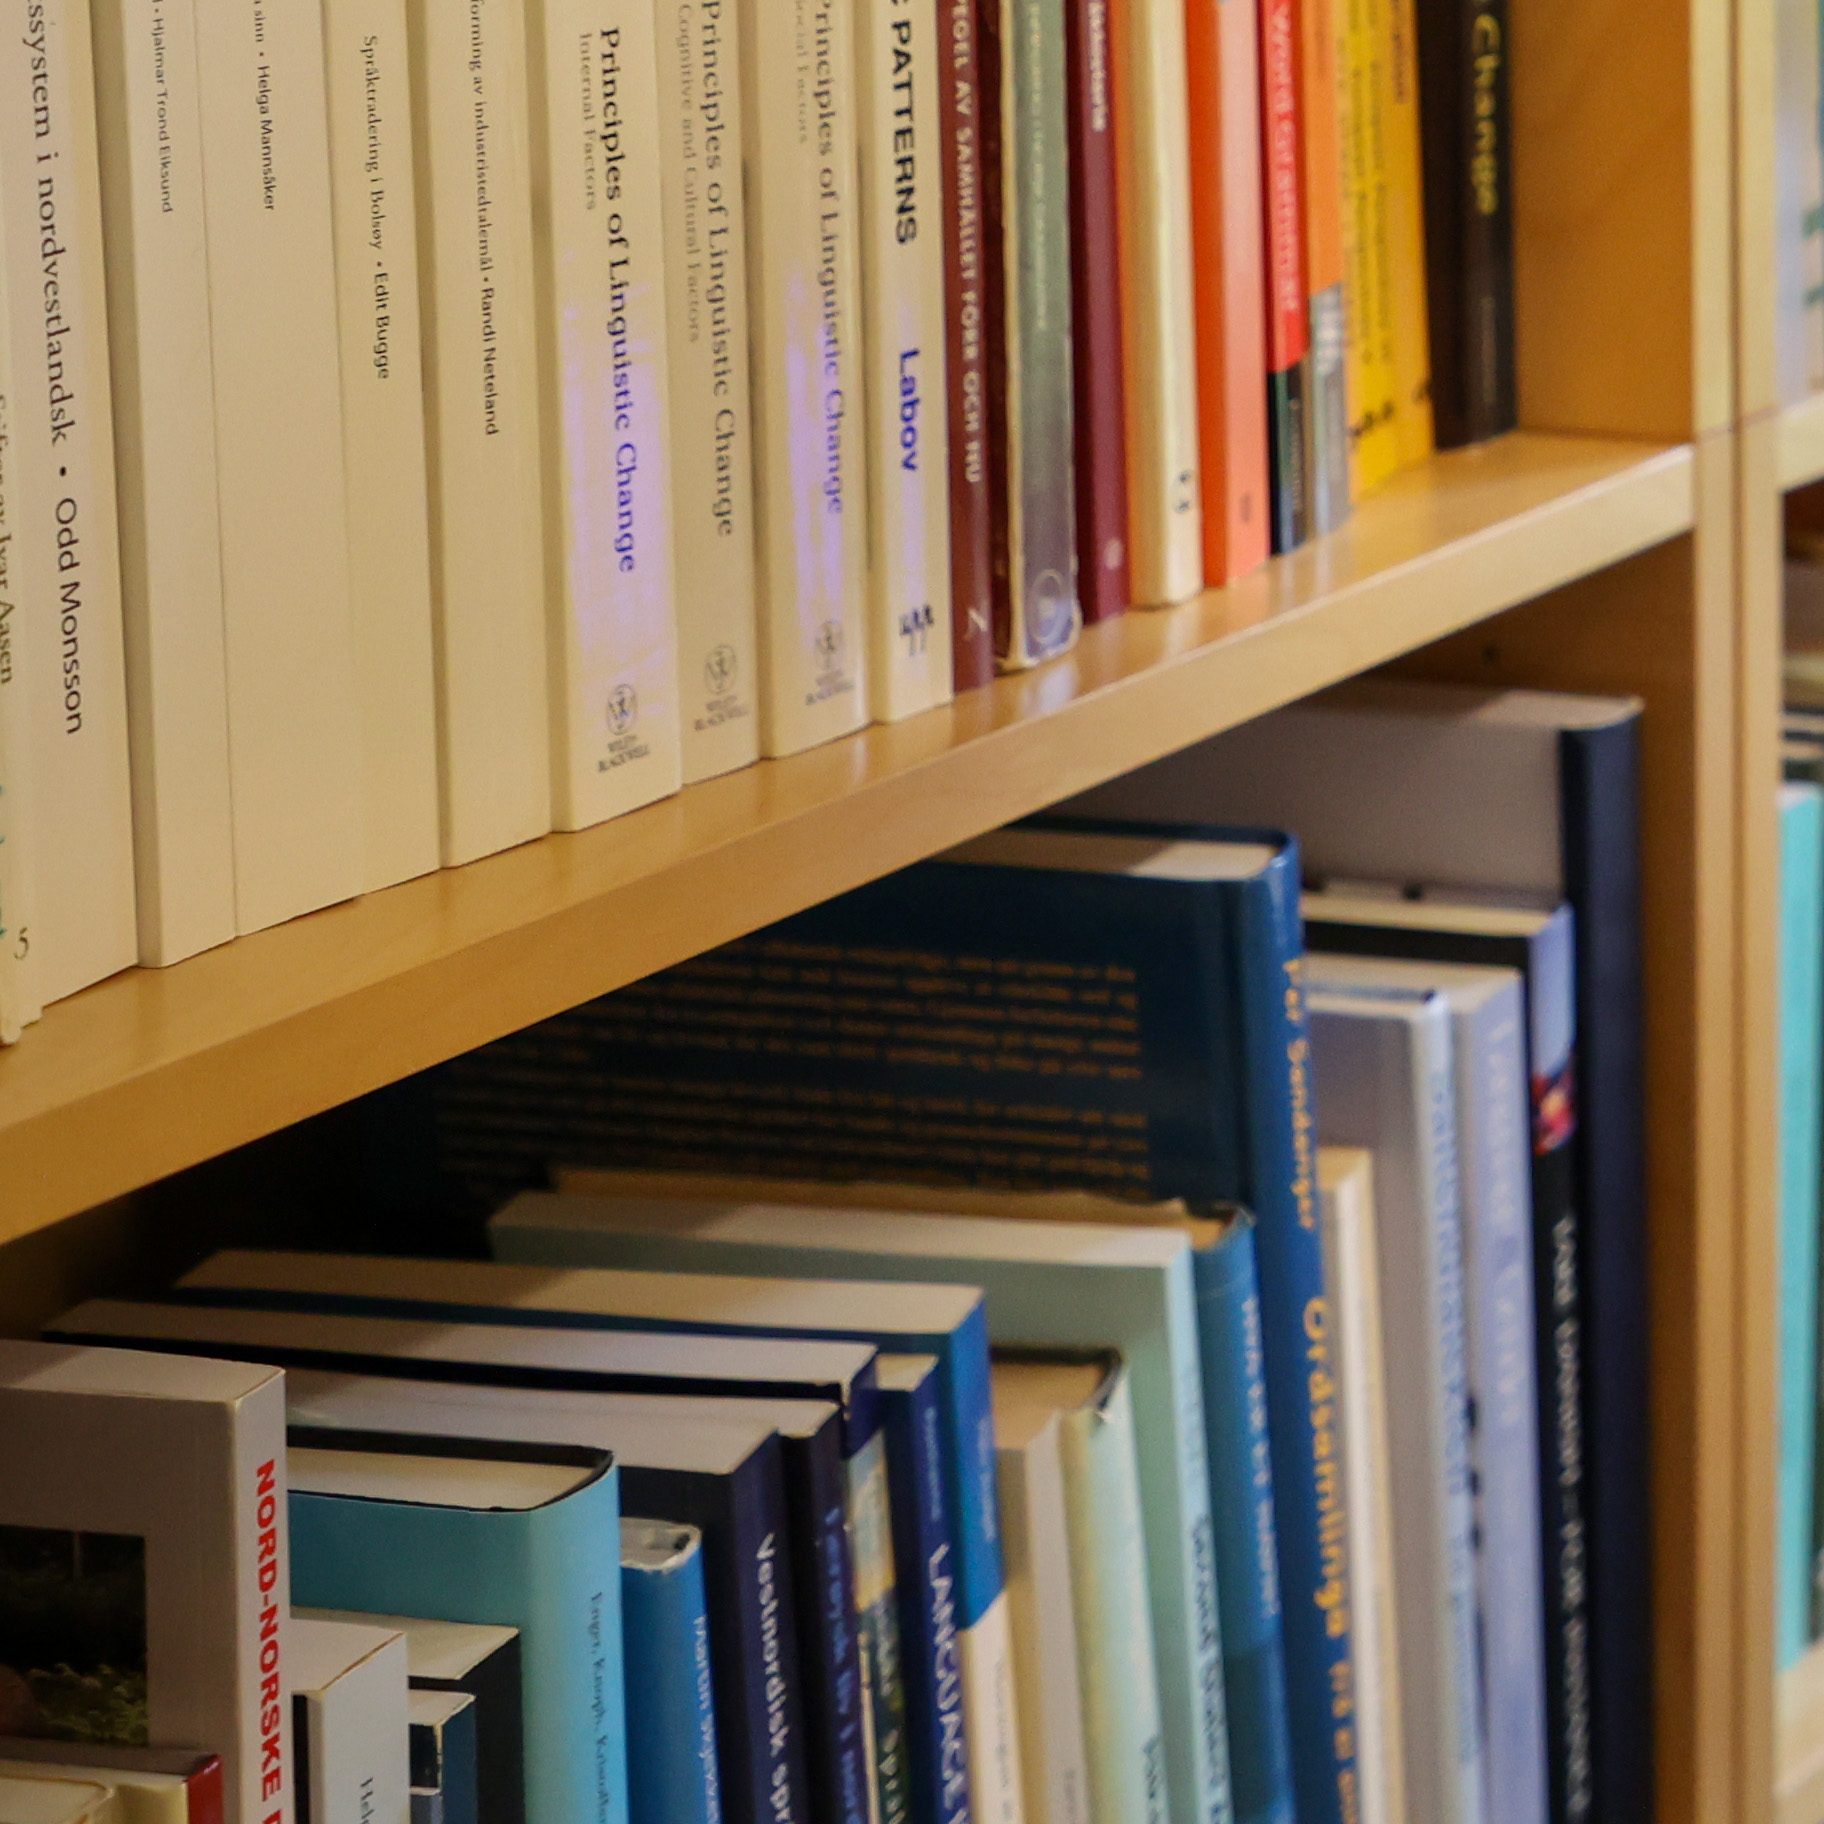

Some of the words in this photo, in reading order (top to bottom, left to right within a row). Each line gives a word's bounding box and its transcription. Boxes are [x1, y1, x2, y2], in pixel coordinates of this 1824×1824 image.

[151, 16, 169, 85] Hjalmar
[252, 9, 266, 44] sinn
[674, 3, 698, 111] Cognitive
[155, 88, 171, 142] Trond
[254, 64, 272, 116] Helga
[360, 34, 383, 173] Språktradering
[472, 76, 484, 96] av
[579, 32, 595, 121] Internal
[594, 27, 625, 202] Principles
[699, 0, 726, 170] Principles
[956, 80, 974, 116] AV
[1471, 14, 1502, 215] Change
[36, 151, 59, 164] i
[258, 119, 276, 211] Mannsåker
[583, 129, 598, 210] Factors
[681, 119, 698, 160] and
[891, 20, 917, 246] PATTERNS
[157, 144, 174, 214] Eiksund
[366, 189, 386, 251] Bolsøy
[474, 101, 494, 273] industristedtalemål
[683, 167, 700, 255] Cultural
[706, 182, 728, 218] of
[817, 166, 840, 203] of
[606, 212, 628, 250] of
[37, 176, 73, 446] nordvestlandsk
[372, 271, 391, 313] Edit
[480, 287, 497, 344] Randi
[686, 262, 702, 344] Factors
[705, 227, 733, 397] Linguistic
[814, 211, 843, 376] Linguistic
[372, 316, 392, 381] Bugge
[605, 256, 635, 432] Linguistic
[482, 348, 501, 437] Neteland
[898, 346, 920, 472] Labov
[710, 408, 738, 536] Change
[820, 388, 845, 515] Change
[54, 497, 80, 572] Odd
[612, 440, 640, 573] Change
[58, 581, 84, 736] Monsson
[13, 926, 30, 960] 5
[258, 1458, 283, 1803] NORD-NORSKE
[757, 1532, 791, 1758] Vestnordisk
[931, 1543, 968, 1809] LANGUAGE
[772, 1763, 796, 1824] spr
